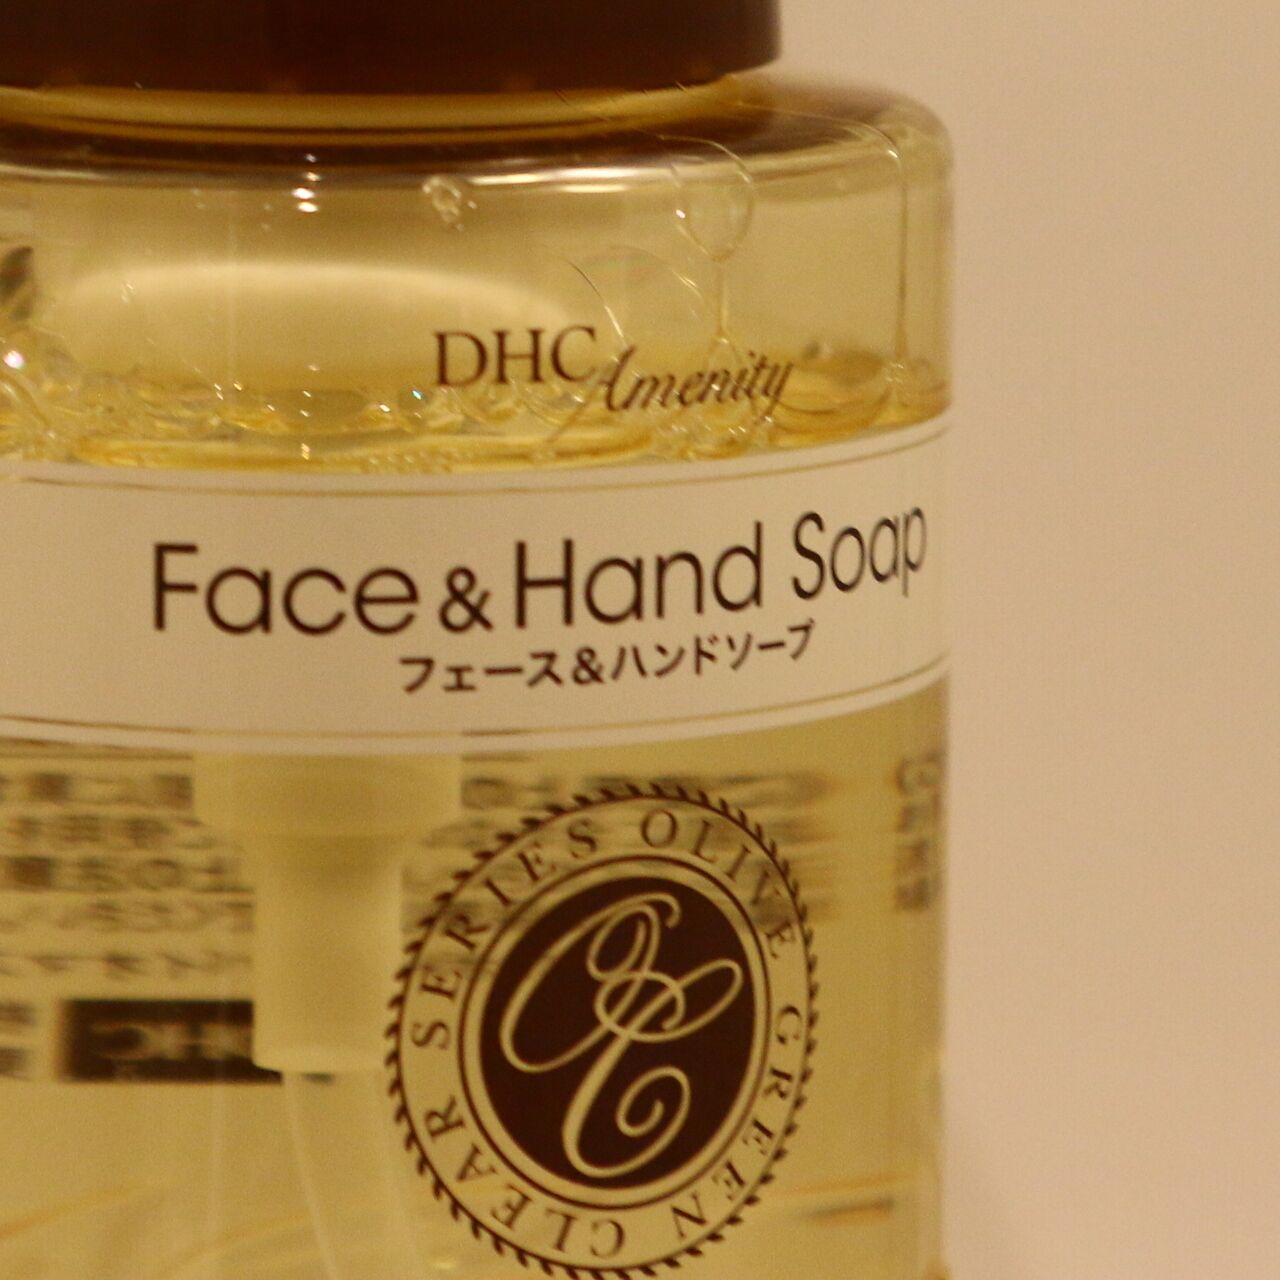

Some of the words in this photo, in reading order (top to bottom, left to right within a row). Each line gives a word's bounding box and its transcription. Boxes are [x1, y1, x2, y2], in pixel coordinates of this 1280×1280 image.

[434, 324, 597, 387] DHC
[592, 344, 794, 418] Amenity
[152, 542, 420, 636] Face
[514, 520, 764, 630] Hand
[790, 506, 928, 599] Soap
[410, 818, 600, 1051] SERIES
[640, 809, 797, 958] OLIVE
[424, 1094, 626, 1259] CLEAR
[672, 1004, 802, 1238] GREEN
